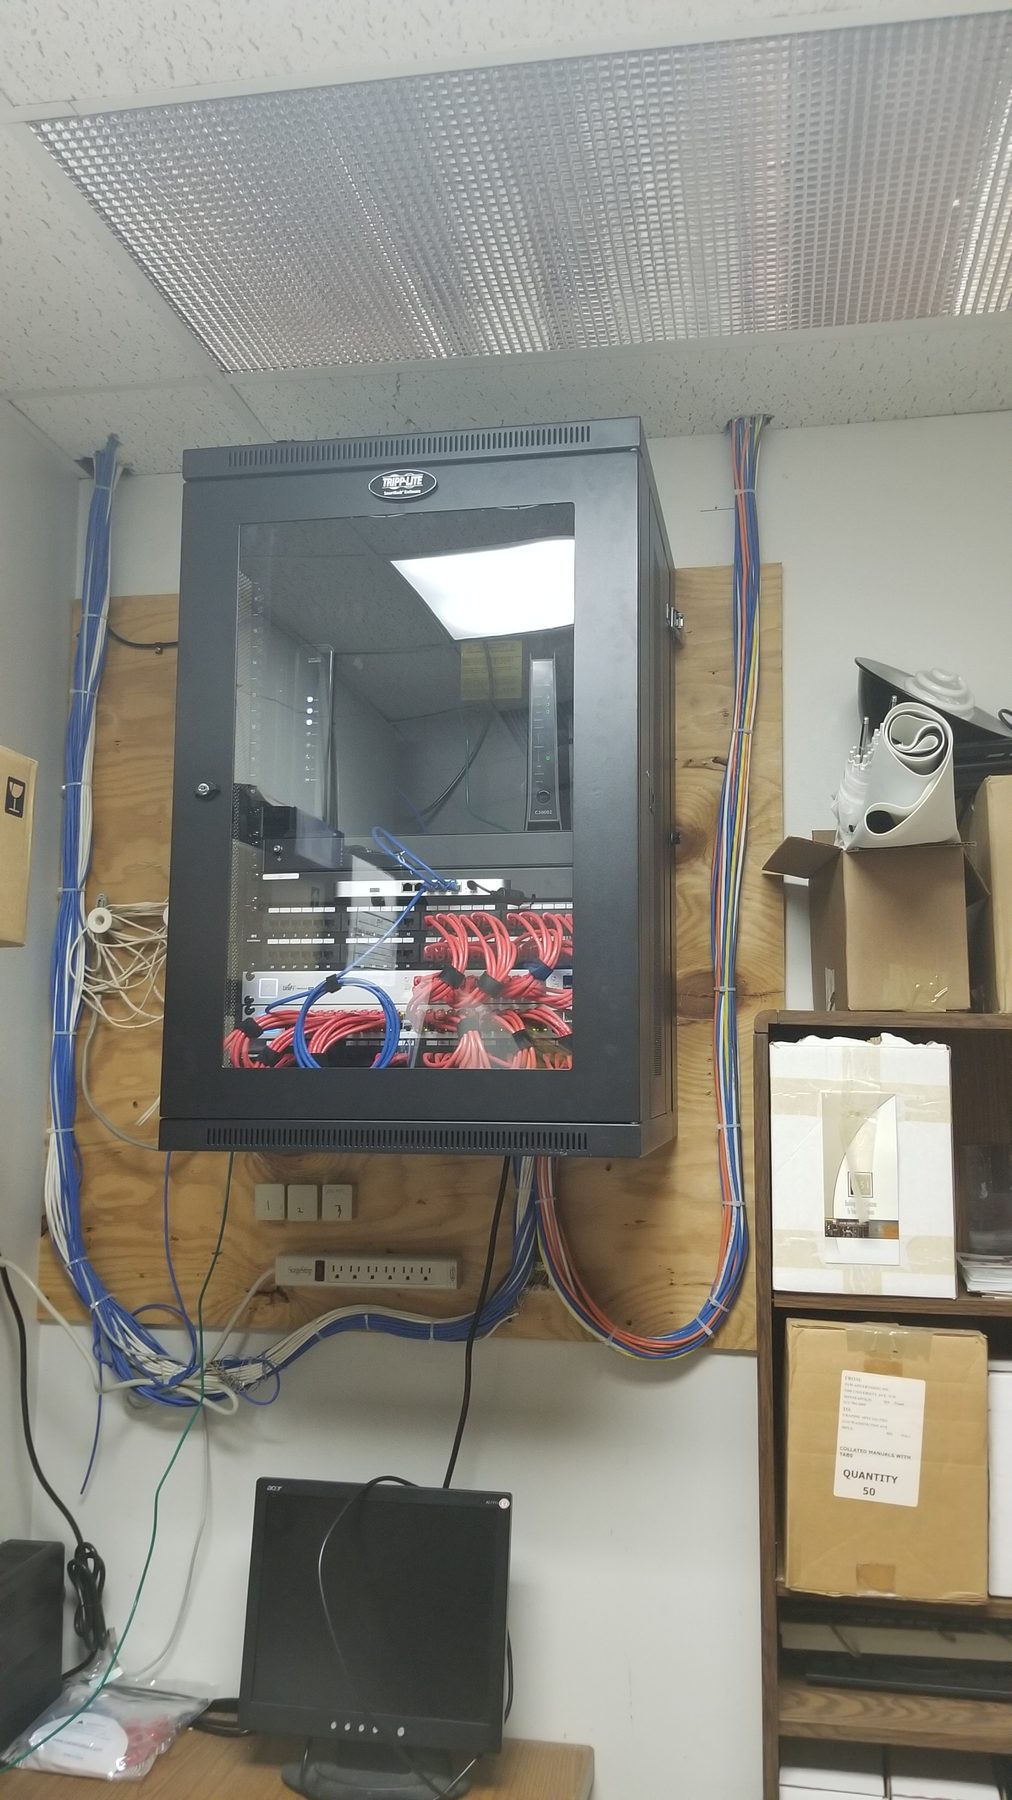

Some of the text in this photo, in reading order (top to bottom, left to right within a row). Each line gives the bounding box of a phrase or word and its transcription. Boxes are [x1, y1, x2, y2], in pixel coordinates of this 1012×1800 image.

[839, 1446, 867, 1454] COLLATED
[868, 1450, 895, 1458] MANUALS
[843, 1469, 899, 1485] QUANTITY
[863, 1486, 876, 1497] 50
